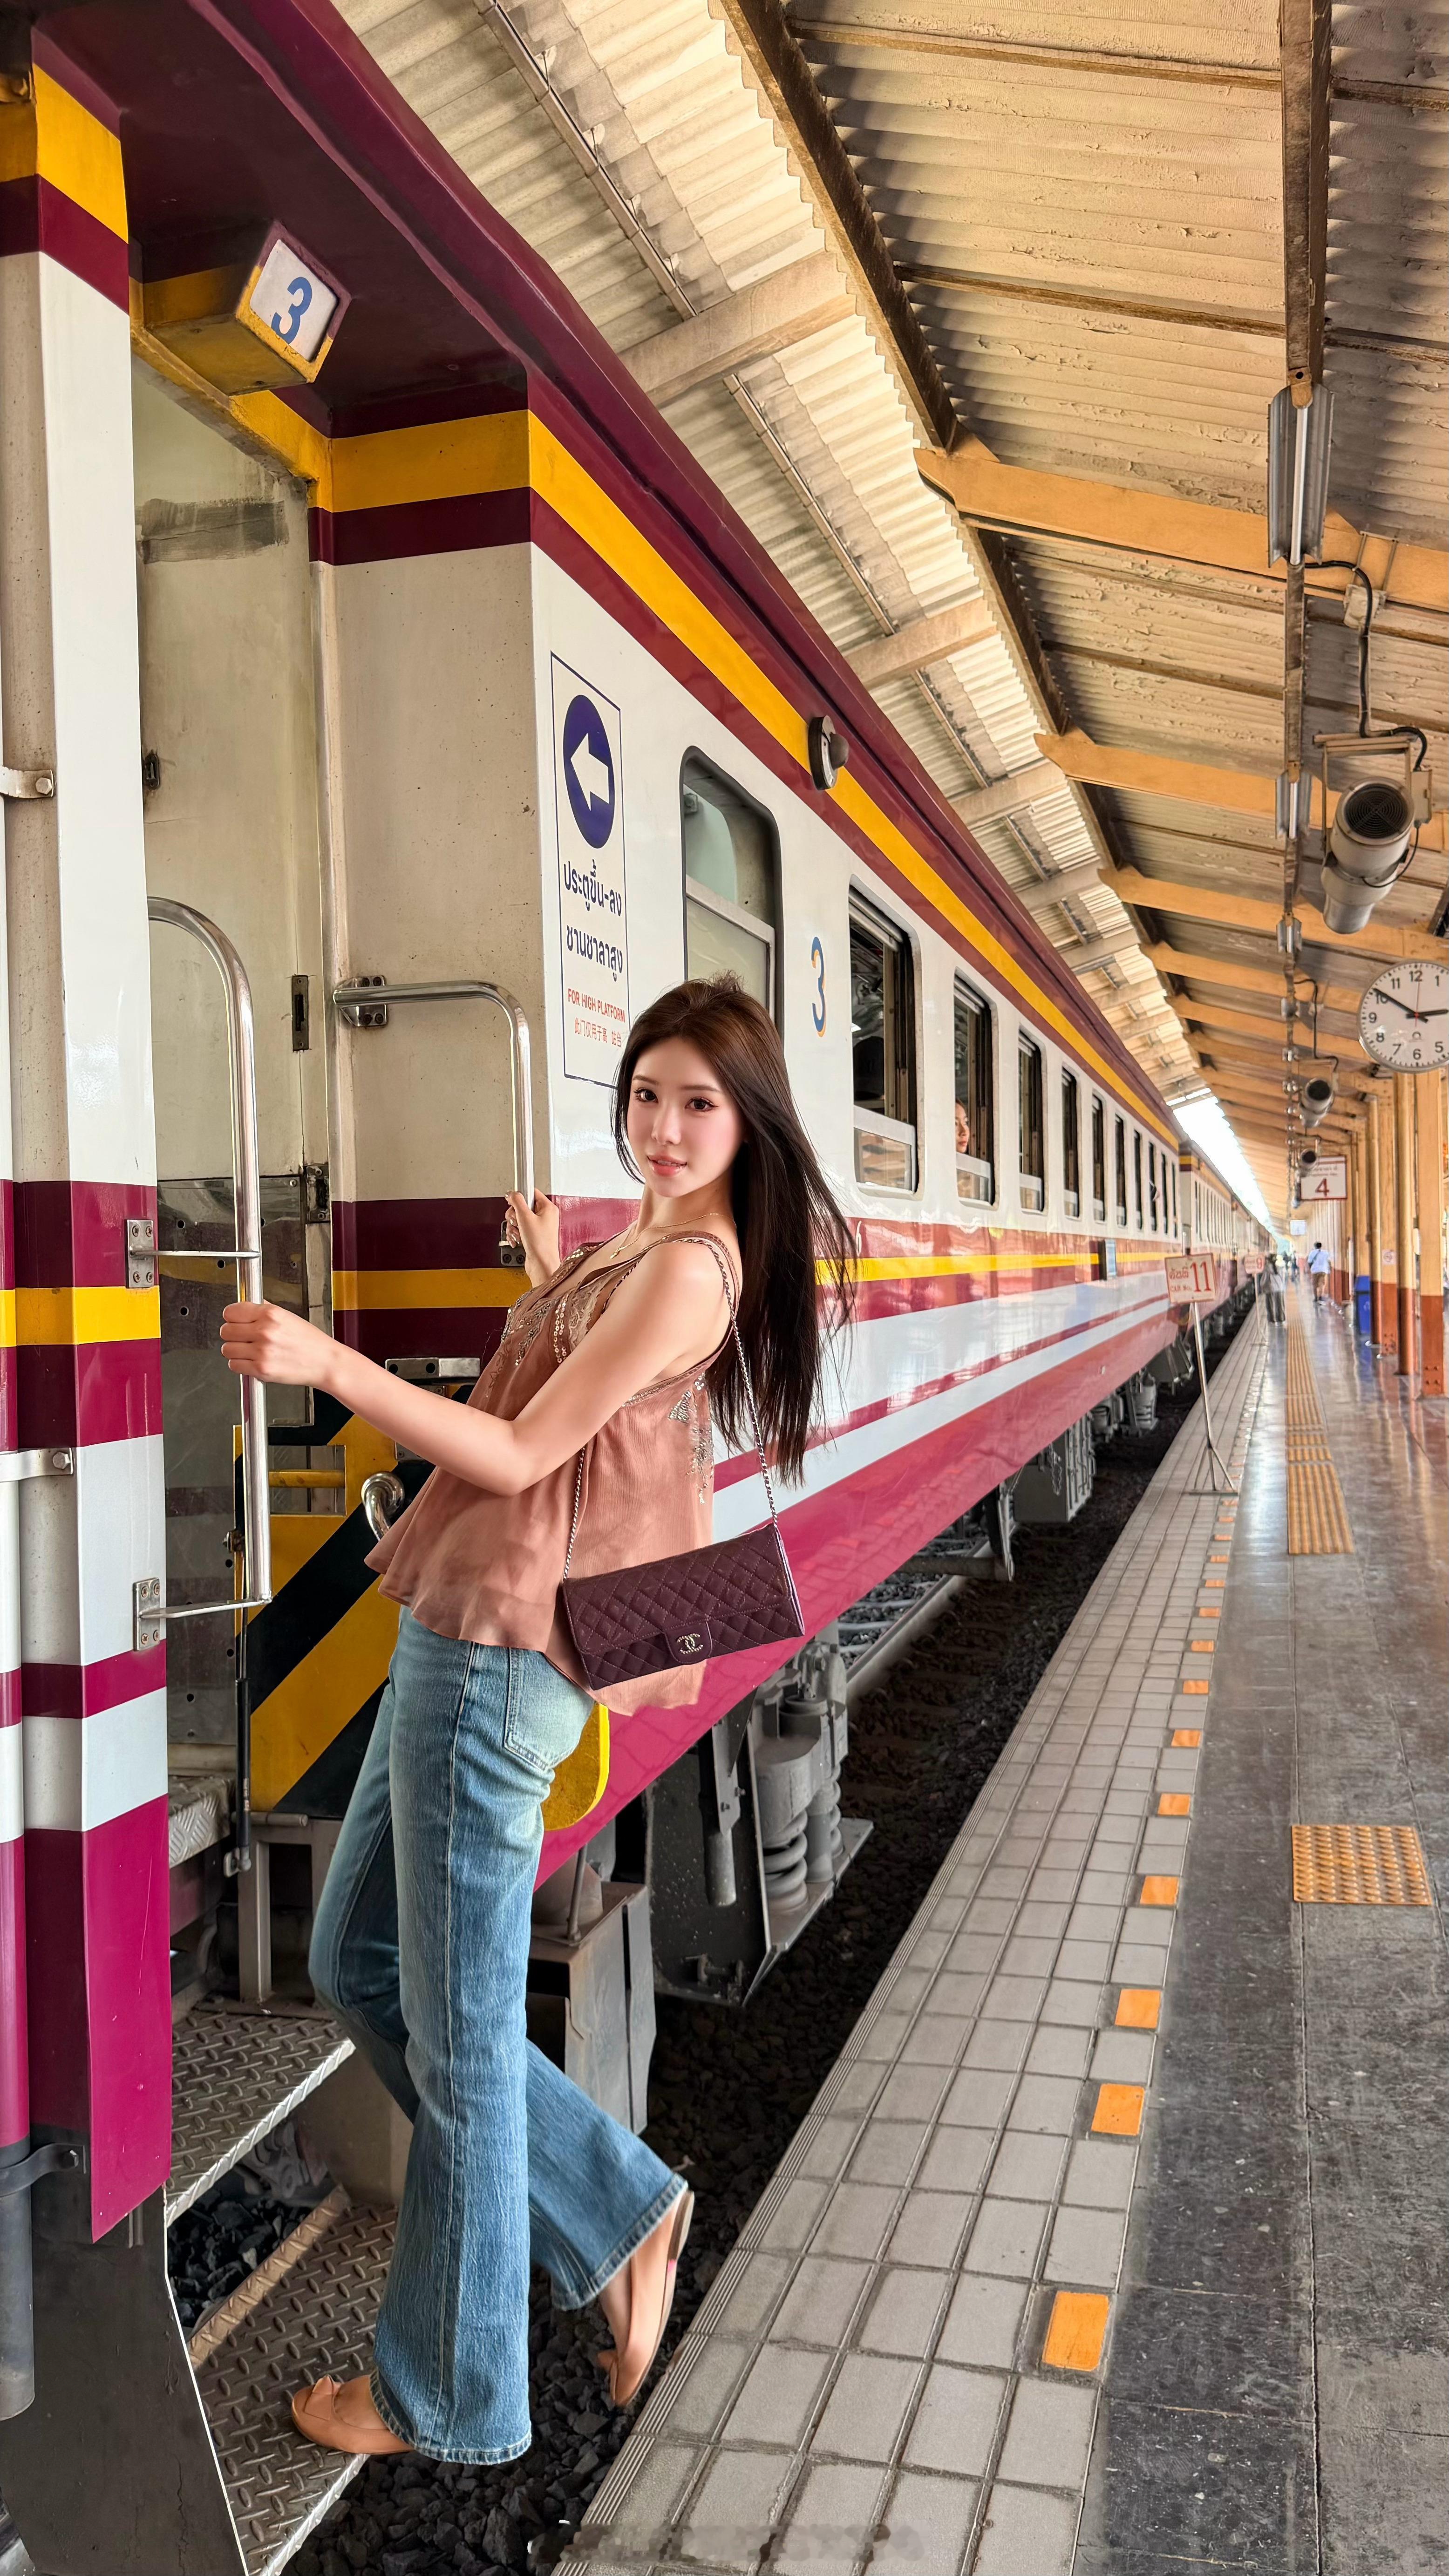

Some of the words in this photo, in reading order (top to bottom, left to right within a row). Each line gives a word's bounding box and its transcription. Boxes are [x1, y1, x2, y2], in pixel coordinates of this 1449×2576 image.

[271, 277, 313, 345] 3
[564, 859, 622, 917] ประตูขึ้น-ลง
[567, 925, 623, 982] ชานชาลาสูง
[1409, 970, 1422, 982] 12
[1435, 975, 1440, 987] 1
[811, 937, 826, 1037] 3
[1391, 977, 1401, 989] 11
[568, 988, 580, 1006] FOR
[581, 993, 596, 1012] HIGH
[598, 999, 626, 1023] PLATFORM
[1368, 1012, 1377, 1023] 9
[1376, 1032, 1384, 1043] 8
[1393, 1044, 1401, 1055] 7
[1435, 1041, 1443, 1053] 5
[1413, 1048, 1421, 1060] 6
[1315, 1177, 1330, 1197] 4
[1190, 1261, 1211, 1292] 11
